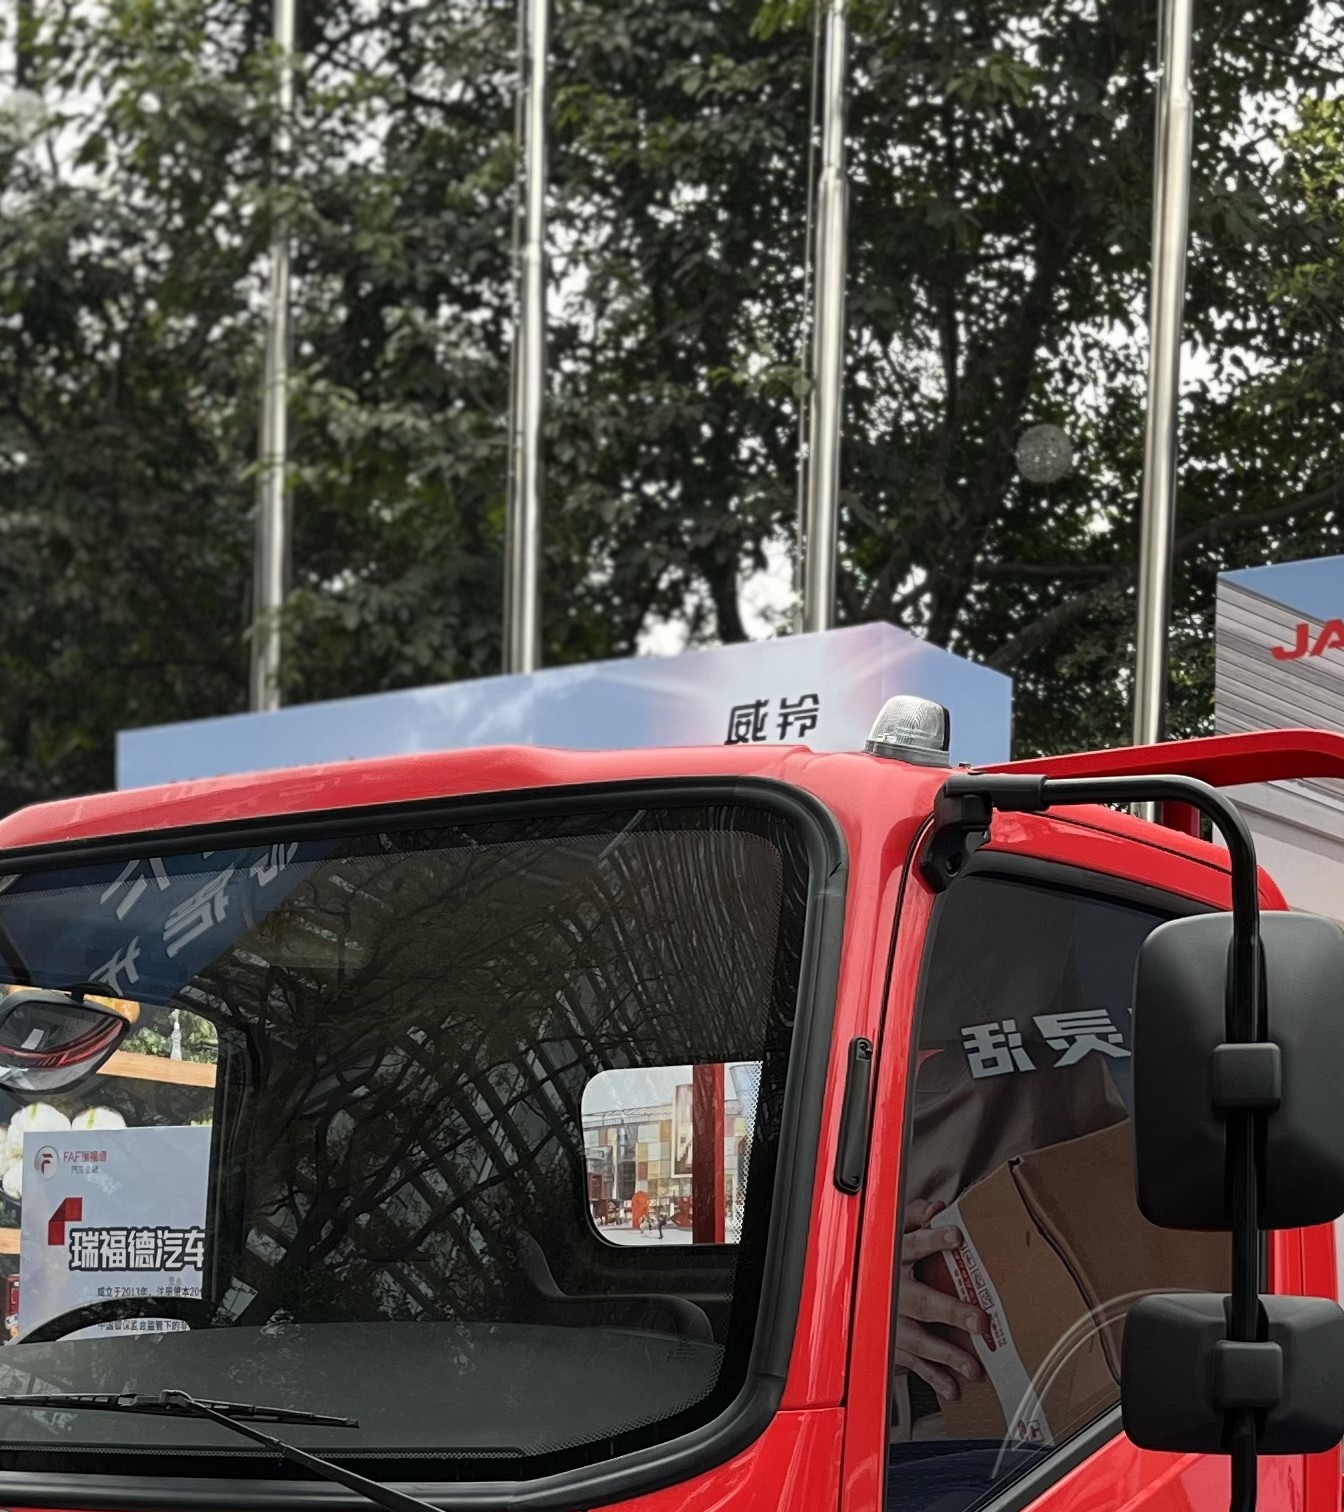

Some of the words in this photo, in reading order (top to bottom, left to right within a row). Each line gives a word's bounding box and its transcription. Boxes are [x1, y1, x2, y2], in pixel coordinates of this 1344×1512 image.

[724, 693, 819, 745] 威铃
[70, 1228, 205, 1269] 瑞福德汽车
